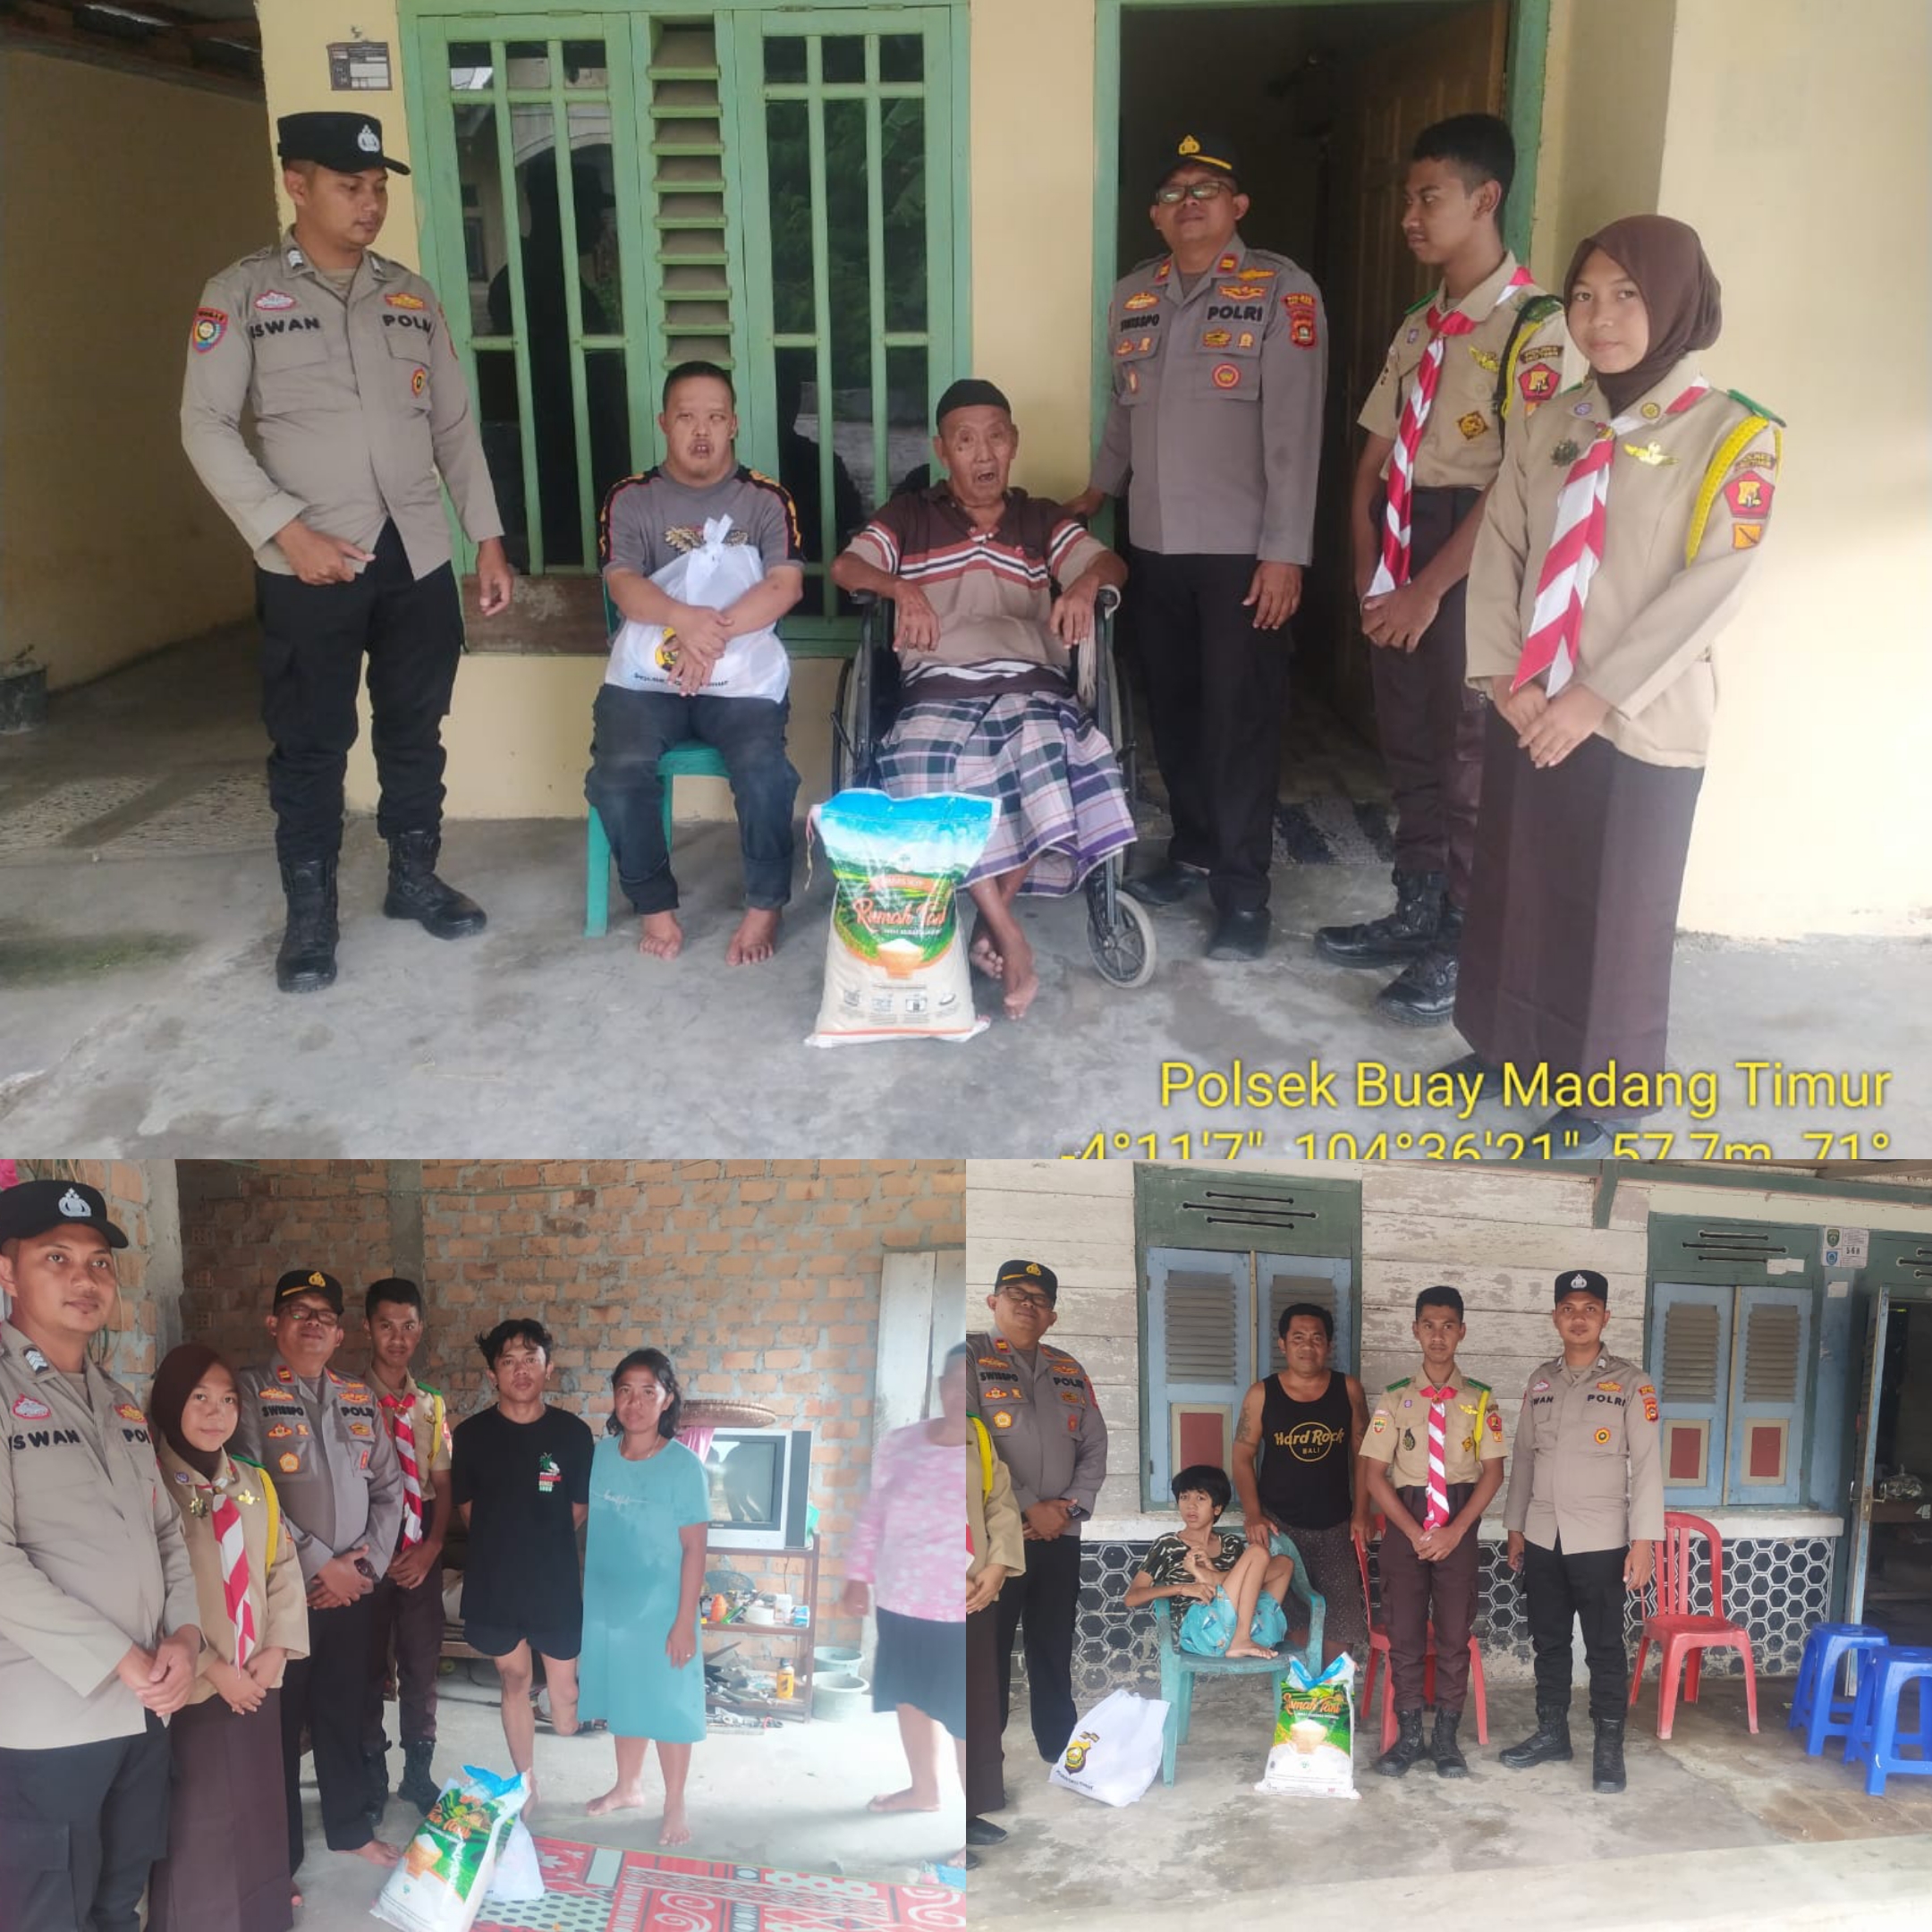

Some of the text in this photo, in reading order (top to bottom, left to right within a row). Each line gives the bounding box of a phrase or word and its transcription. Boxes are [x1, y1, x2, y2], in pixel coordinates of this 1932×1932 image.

[1208, 305, 1263, 322] POLRI
[852, 897, 914, 933] Rumah
[1587, 1394, 1626, 1407] POLRI
[1274, 1428, 1344, 1445] Hard Rock
[1302, 1446, 1320, 1454] BALI
